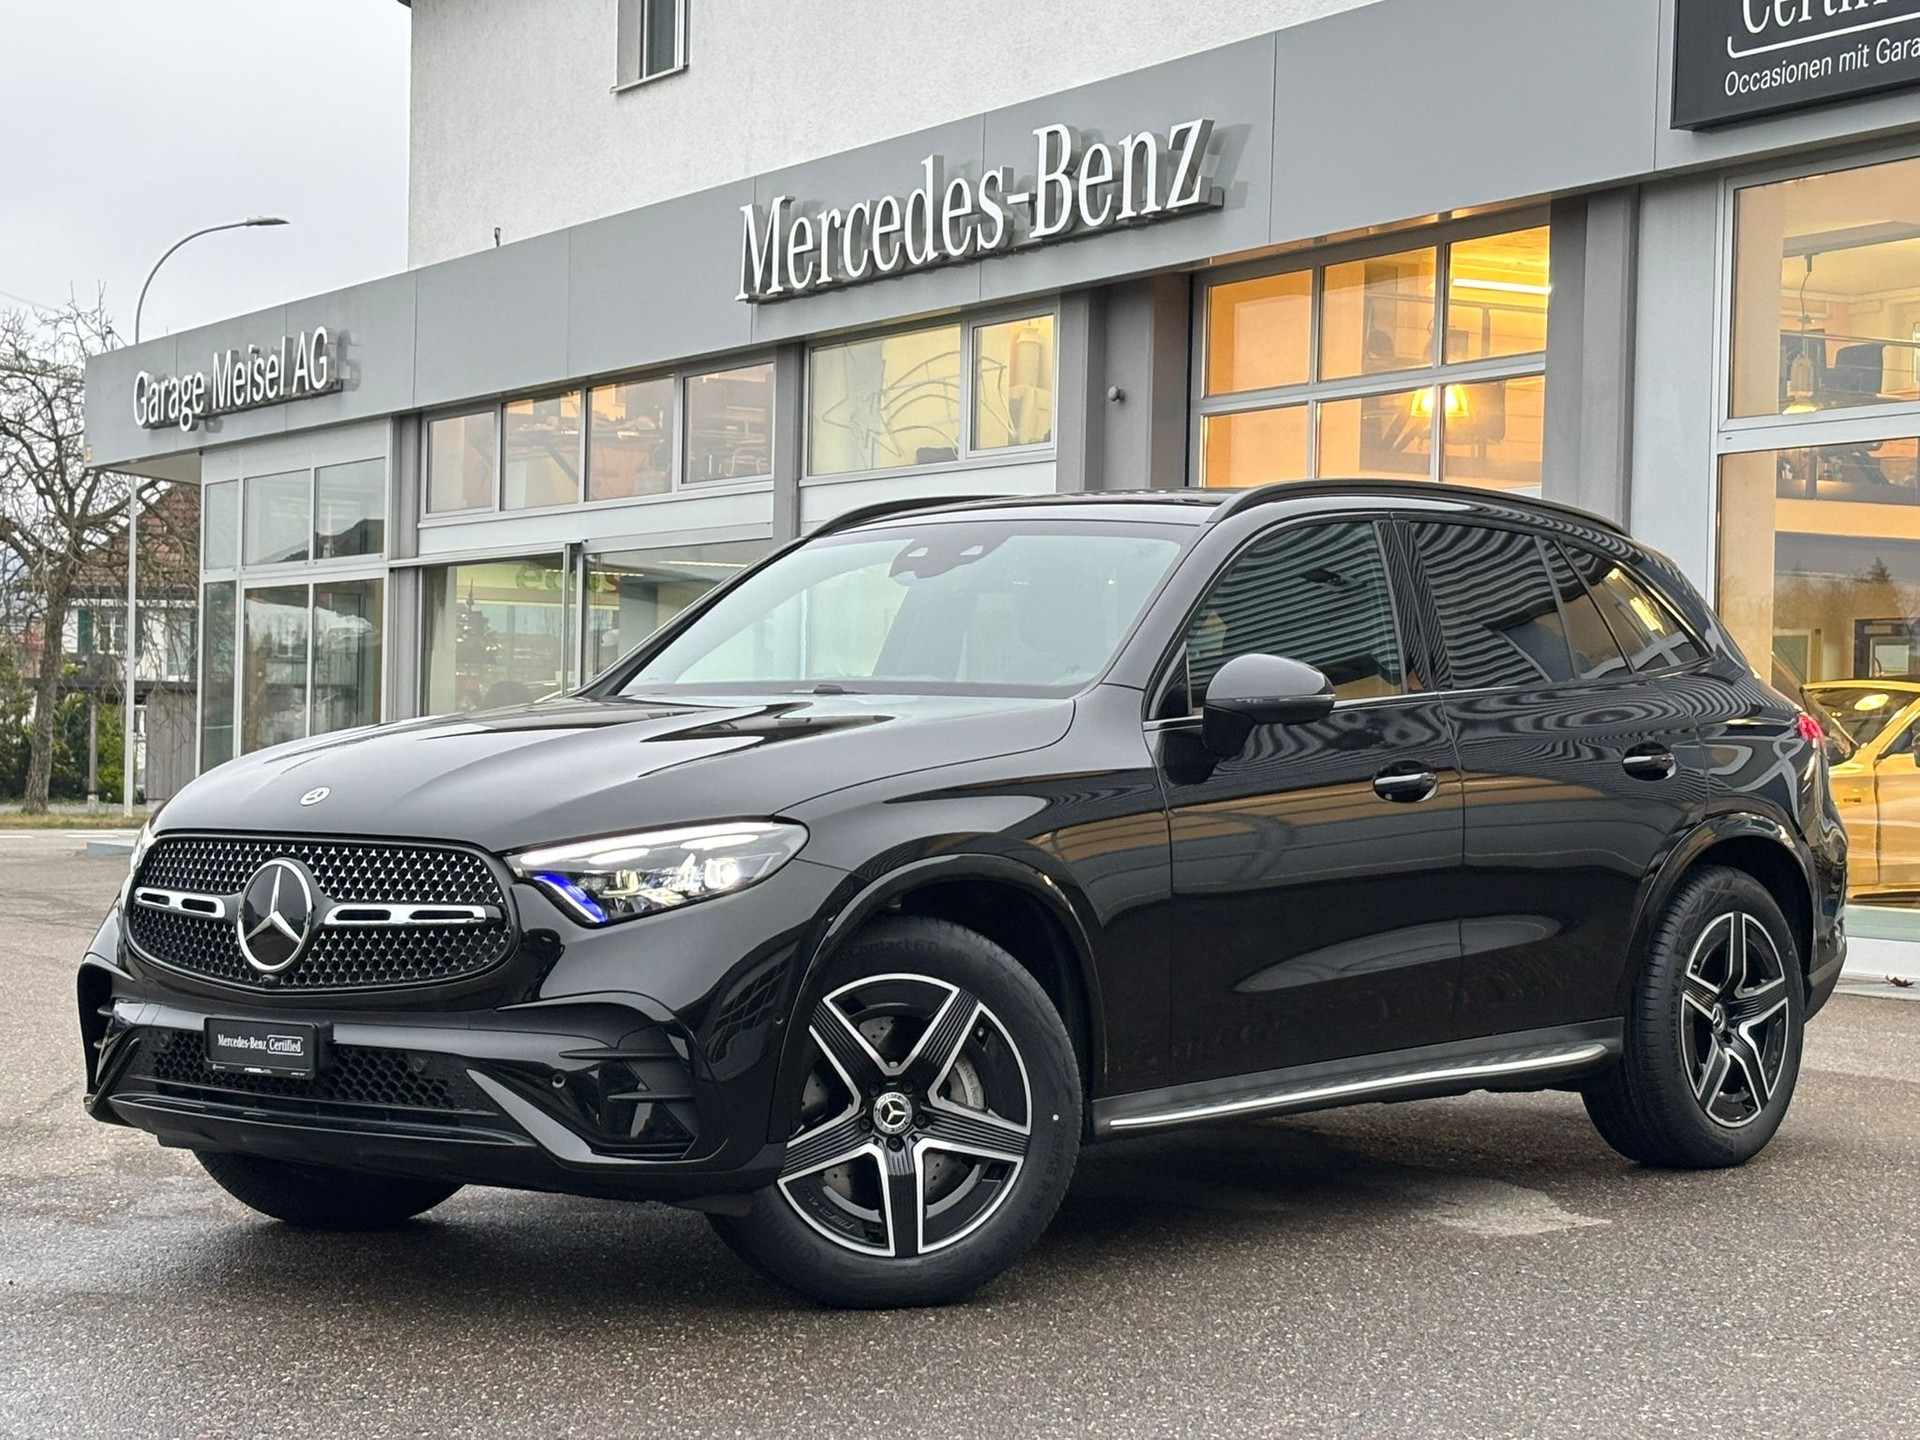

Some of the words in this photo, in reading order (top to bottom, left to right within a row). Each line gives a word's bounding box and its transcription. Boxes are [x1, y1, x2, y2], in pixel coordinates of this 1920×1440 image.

[1724, 57, 1832, 96] Occasionen
[1839, 43, 1870, 73] mit
[1876, 37, 1920, 64] Gara
[735, 119, 1214, 302] Mercedes-Benz
[134, 370, 204, 432] Garage
[212, 335, 289, 410] Meisel
[292, 326, 329, 394] AG
[217, 1034, 267, 1050] Mercedes-Benz
[269, 1038, 301, 1052] Certified
